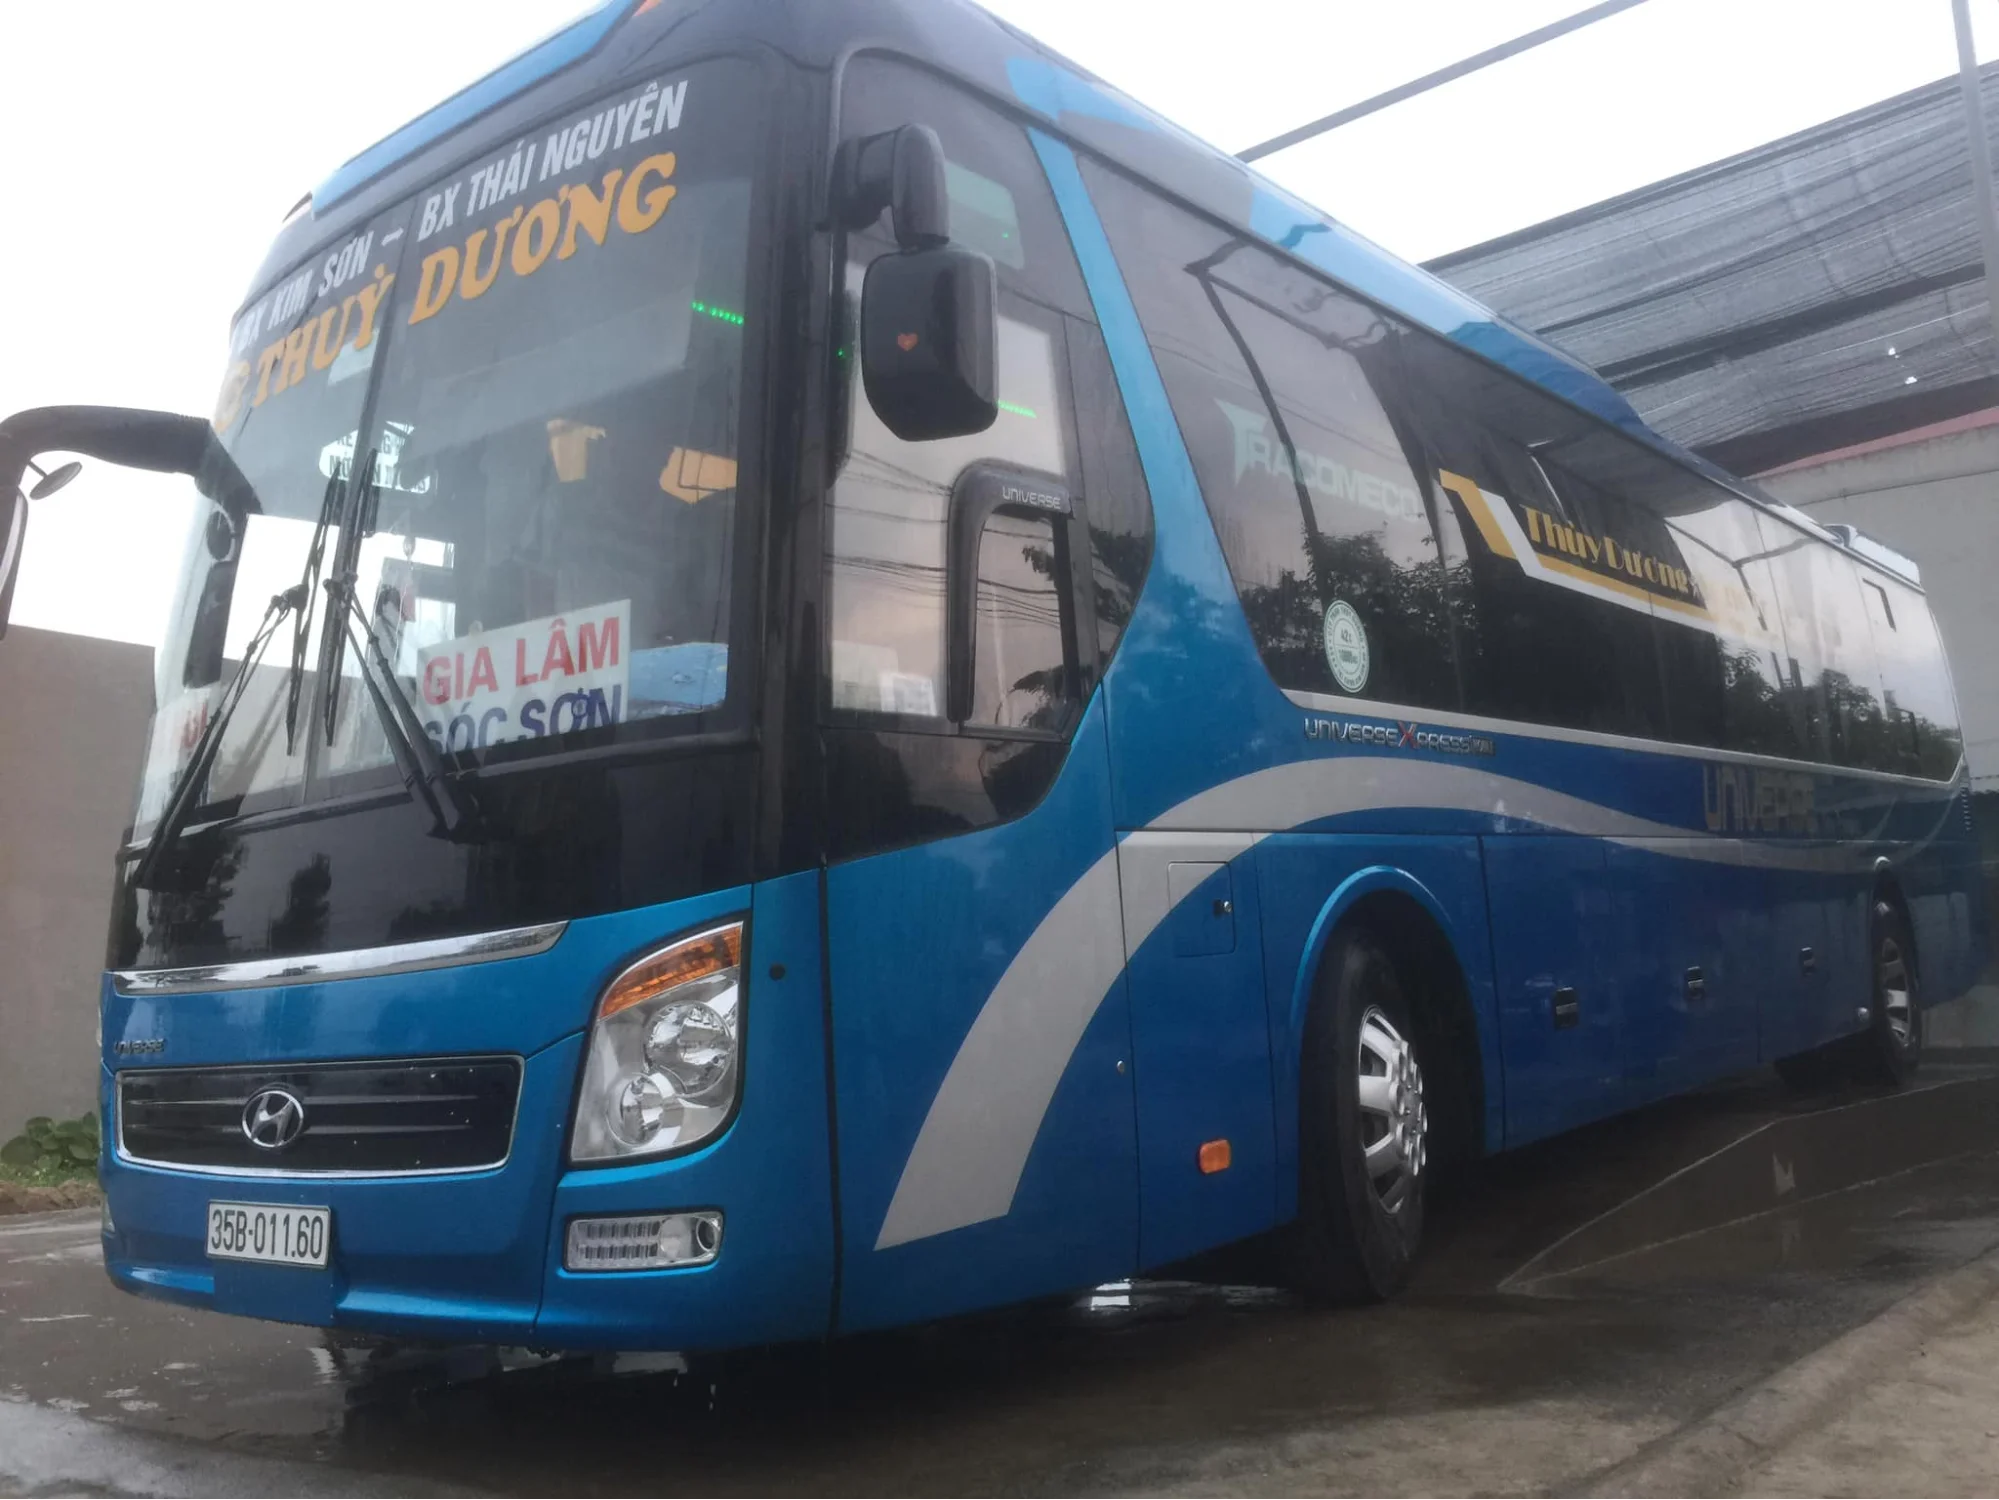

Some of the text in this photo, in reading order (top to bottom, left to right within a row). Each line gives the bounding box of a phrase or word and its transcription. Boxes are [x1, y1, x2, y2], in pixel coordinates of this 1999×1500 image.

[267, 269, 314, 330] KIM
[318, 230, 375, 297] SƠN
[417, 182, 461, 242] BX
[466, 139, 537, 217] THÁI
[540, 80, 688, 182] NGUYÊN
[408, 152, 676, 325] DƯƠNG
[1212, 397, 1420, 522] TRACOMECO
[1002, 485, 1061, 509] UNIVERSE
[1602, 534, 1689, 593] Dương
[423, 617, 620, 706] GIA LÂM
[425, 700, 508, 754] SÓC
[211, 1209, 323, 1259] 35B-011.60
